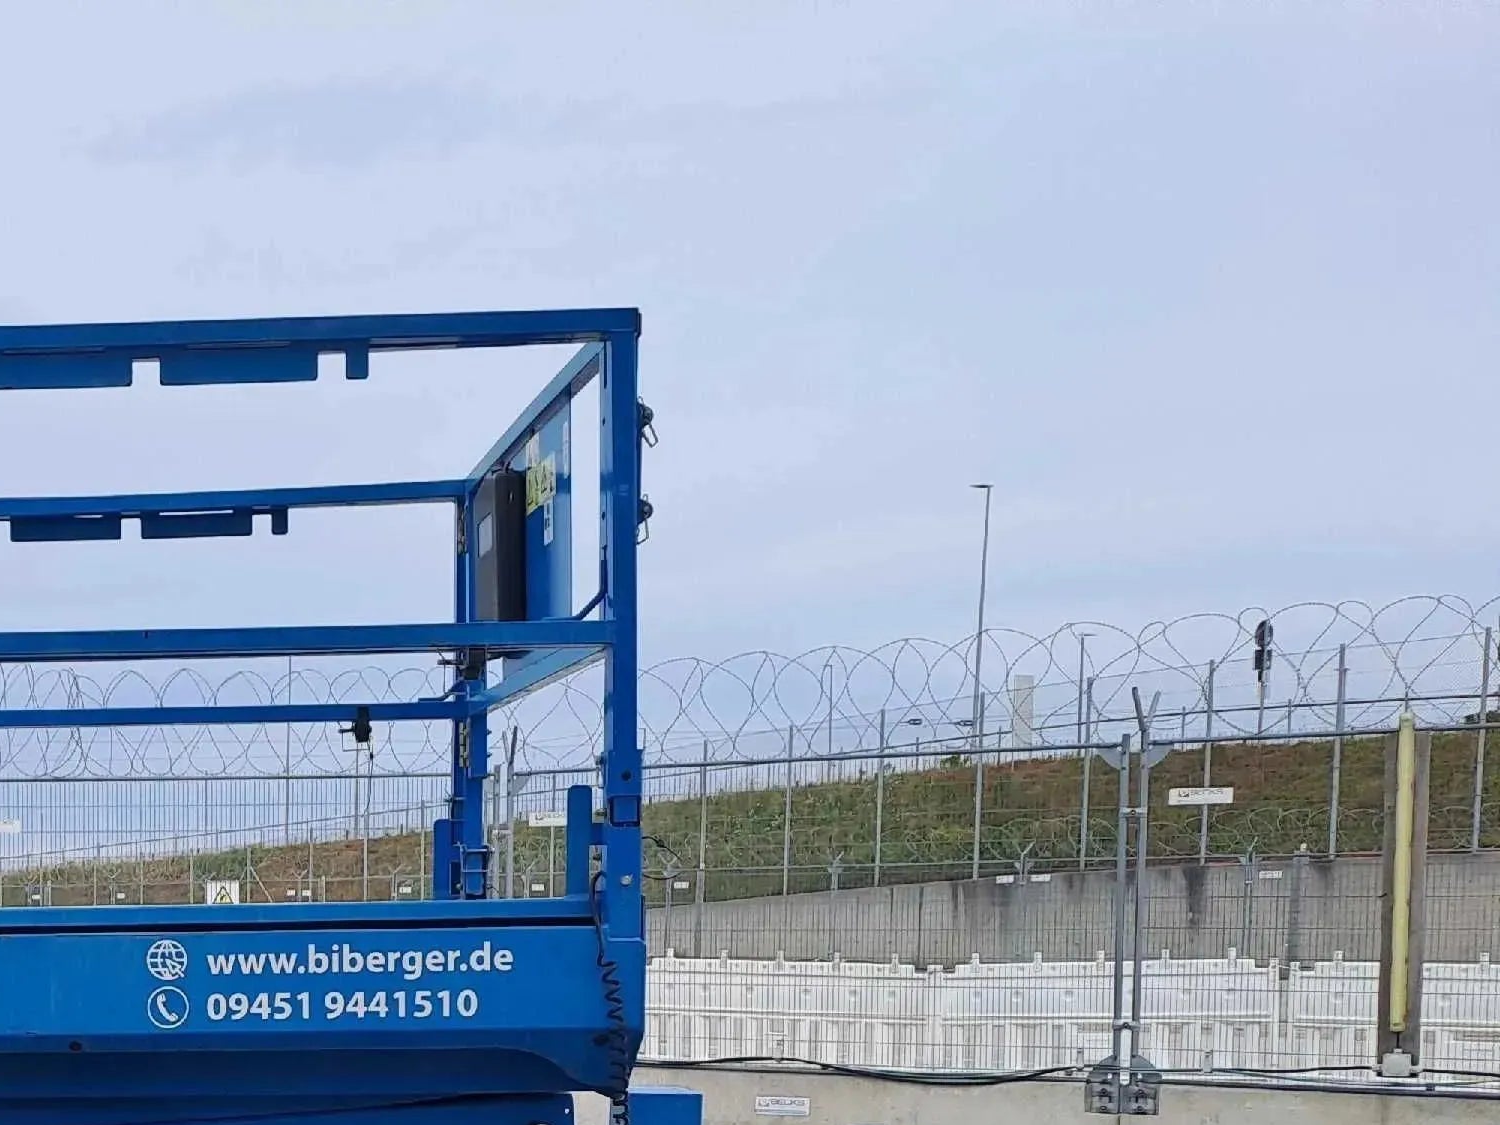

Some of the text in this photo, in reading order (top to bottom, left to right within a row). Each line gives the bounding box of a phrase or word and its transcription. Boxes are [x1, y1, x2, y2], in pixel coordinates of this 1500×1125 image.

[206, 941, 515, 980] www.biberger.de
[206, 989, 479, 1021] 09451 9441510
